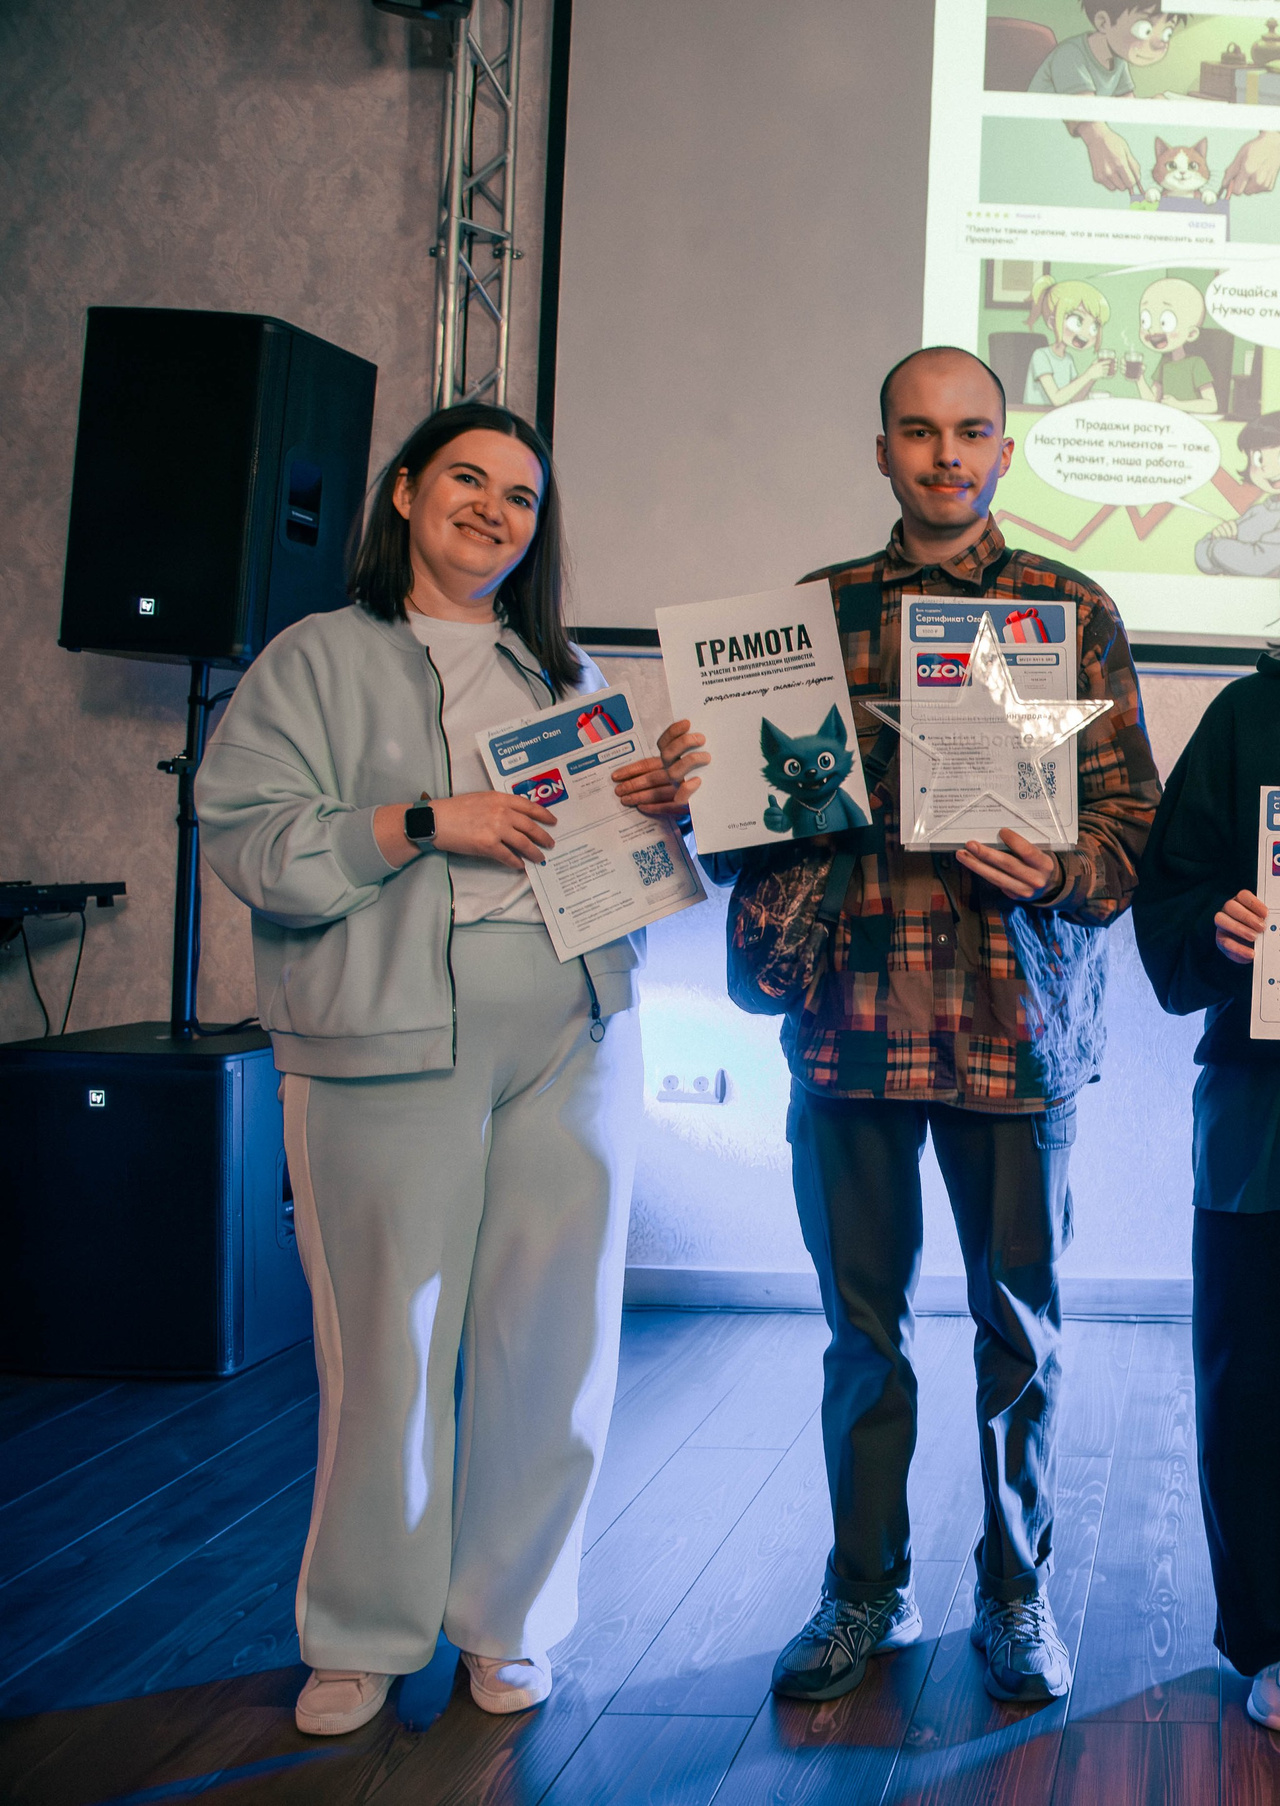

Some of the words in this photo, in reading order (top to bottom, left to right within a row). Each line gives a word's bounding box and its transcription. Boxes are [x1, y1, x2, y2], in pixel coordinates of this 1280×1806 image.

[1143, 234, 1193, 243] перевозить
[1212, 284, 1278, 299] Угощайся
[1212, 303, 1255, 318] Нужно
[1075, 418, 1130, 432] Продажи
[1034, 434, 1104, 447] Настроение
[1108, 440, 1164, 450] клиентов
[1054, 453, 1063, 463] А
[1066, 456, 1109, 466] значит,
[1112, 457, 1142, 466] наша
[916, 614, 964, 624] Сертификат
[694, 623, 813, 668] ГРАМОТА
[708, 667, 731, 678] УЧАСТИЕ
[498, 735, 541, 756] Сертификат
[542, 729, 562, 740] Ozon
